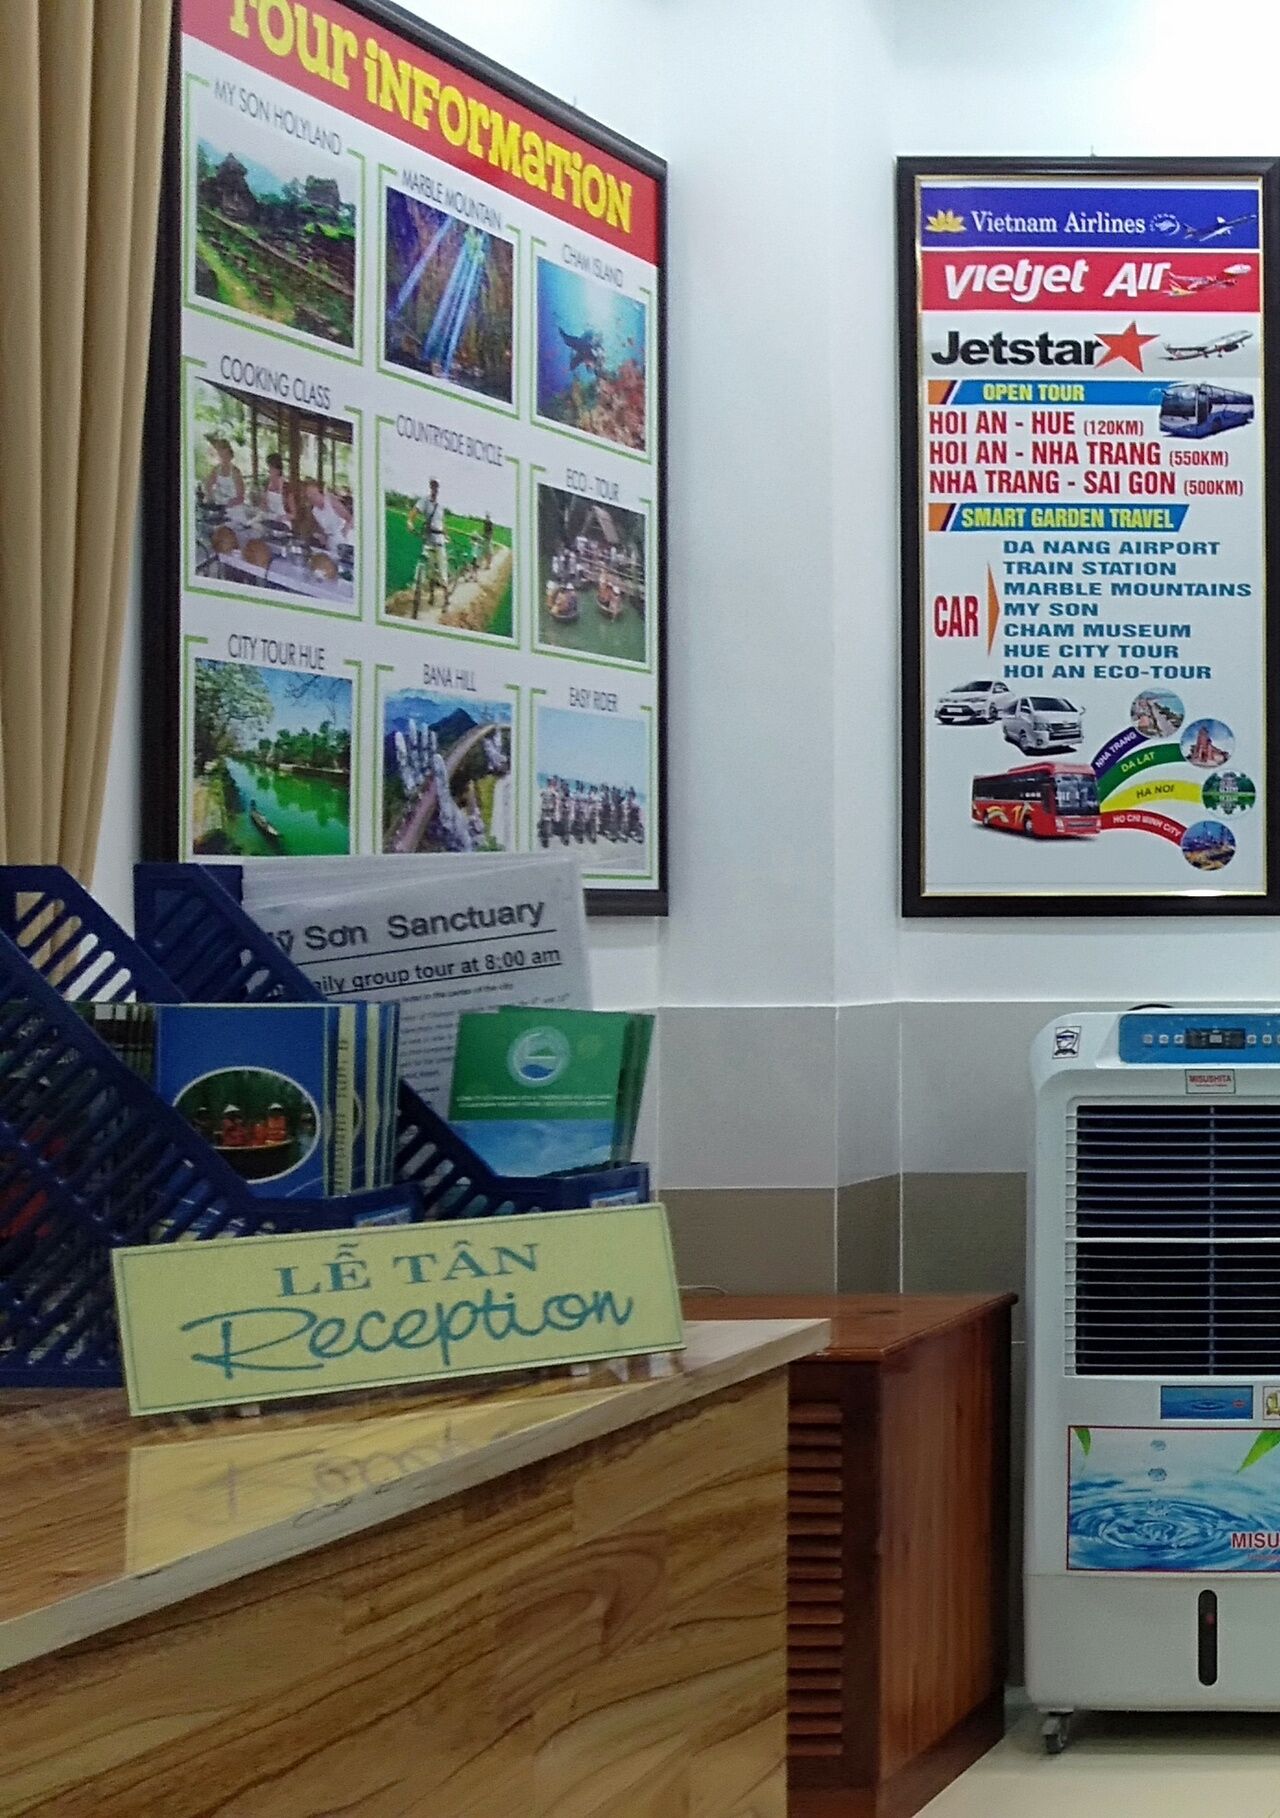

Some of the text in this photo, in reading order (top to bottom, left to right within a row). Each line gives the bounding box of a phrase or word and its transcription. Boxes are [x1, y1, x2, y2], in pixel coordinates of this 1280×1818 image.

[214, 80, 342, 156] MY SON HOLYLAND
[402, 169, 502, 230] MARBLE MOUNTAIN
[970, 210, 1058, 233] Vietnam
[1064, 211, 1146, 233] Airlines
[562, 243, 624, 288] CHAM ISLAND
[1104, 262, 1172, 298] Air
[931, 330, 1100, 366] Jetstar
[220, 355, 331, 411] COOKING CLASS
[983, 383, 1086, 402] OPEN TOUR
[928, 411, 968, 435] HOI
[976, 411, 1008, 435] AN
[1031, 411, 1076, 435] HUE
[1083, 419, 1144, 438] (120KM)
[396, 414, 504, 467] COUNTRYSIDE BICYCLE
[928, 442, 968, 465] HOI
[976, 442, 1008, 465] AN
[1031, 442, 1080, 465] NHA
[1088, 442, 1162, 466] TRANG
[1169, 449, 1229, 468] (550KM)
[566, 468, 587, 492] ECO
[595, 476, 620, 502] TOUR
[928, 471, 978, 494] NHA
[985, 471, 1059, 495] TRANG
[1083, 471, 1121, 495] SAI
[1128, 471, 1176, 495] GON
[1183, 478, 1244, 497] (500KM)
[961, 507, 1174, 529] SMART GARDEN TRAVEL
[1003, 541, 1220, 556] DA NANG AIRPORT
[1003, 561, 1177, 576] TRAIN STATION
[1003, 582, 1252, 597] MARBLE MOUNTAINS
[933, 595, 979, 638] CAR
[1003, 602, 1099, 617] MY SON
[1003, 624, 1192, 638] CHAM MUSEUM
[227, 634, 326, 670] CITY TOUR HUE
[1003, 644, 1180, 659] HUE CITY TOUR
[423, 663, 477, 692] BANA HILL
[1003, 665, 1213, 680] HOI AN ECO-TOUR
[569, 687, 618, 712] EASY RIDER
[1095, 731, 1138, 768] NHA TRANG
[1121, 751, 1156, 773] DA LAT
[1136, 784, 1175, 799] HA NOI
[1162, 822, 1182, 838] CITY
[304, 924, 368, 951] Sơn
[388, 902, 545, 940] Sanctuary
[352, 967, 410, 991] group
[415, 961, 455, 980] tour
[461, 956, 480, 974] at
[484, 950, 525, 970] 8:00
[531, 948, 560, 965] am
[273, 1240, 542, 1298] LỄ TÂN
[179, 1285, 635, 1379] Reception
